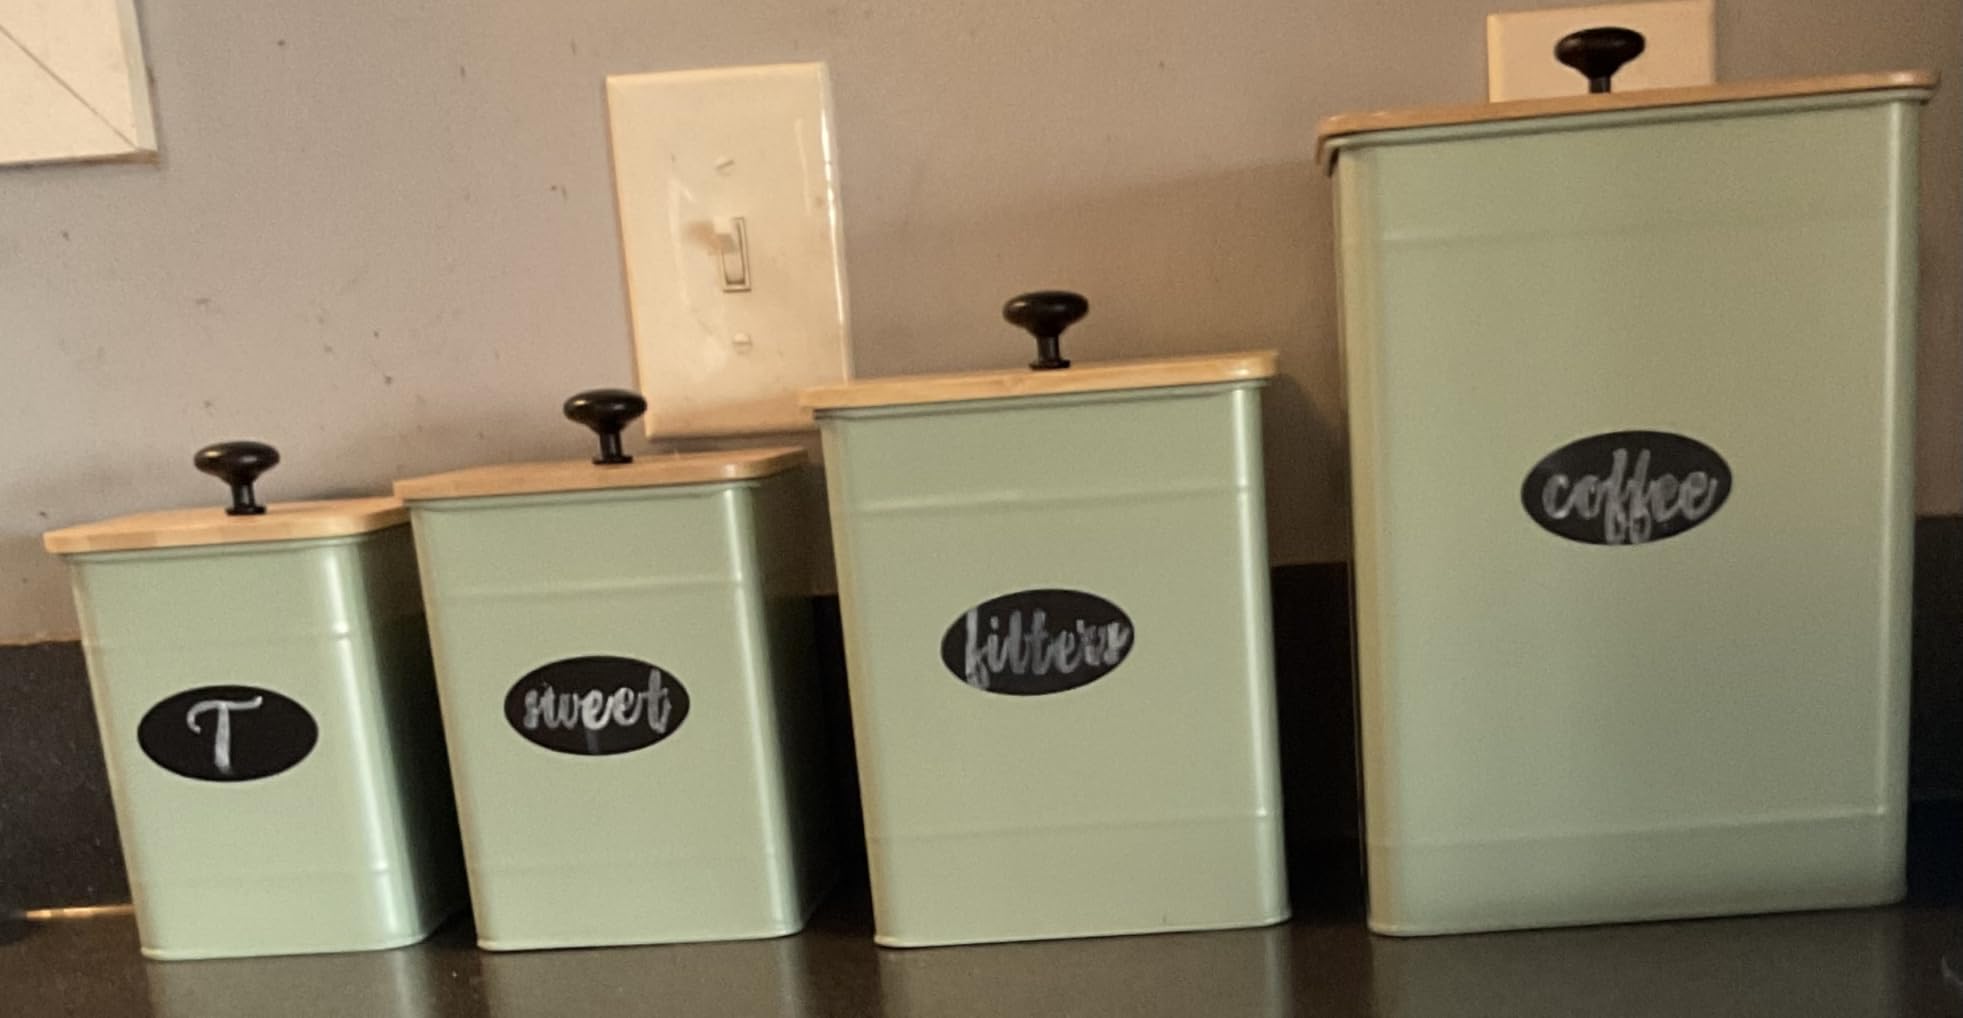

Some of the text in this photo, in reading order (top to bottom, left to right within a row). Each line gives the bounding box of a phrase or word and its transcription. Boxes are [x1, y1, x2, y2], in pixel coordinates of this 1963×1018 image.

[1542, 448, 1718, 544] coffee
[965, 607, 1131, 688] filters
[187, 695, 264, 775] T
[523, 669, 672, 734] sweet
